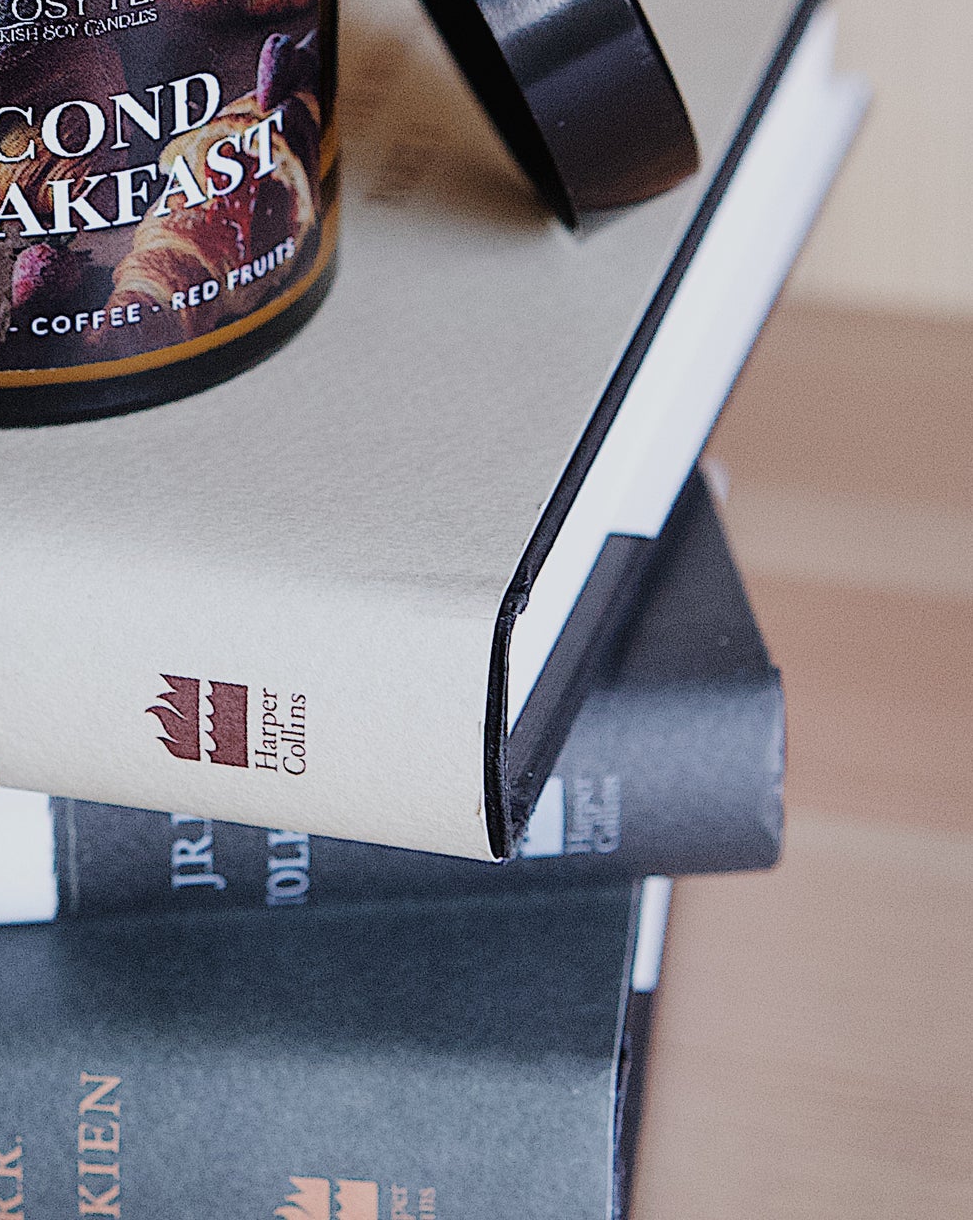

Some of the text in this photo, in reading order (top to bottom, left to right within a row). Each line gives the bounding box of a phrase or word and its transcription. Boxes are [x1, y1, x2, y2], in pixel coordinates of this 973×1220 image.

[43, 23, 80, 41] SOY
[84, 8, 158, 37] CANDLES
[31, 303, 141, 337] COFFEE
[171, 279, 221, 312] RED
[226, 236, 296, 291] FRUITS
[255, 687, 284, 773] Harper
[282, 693, 307, 776] Collins
